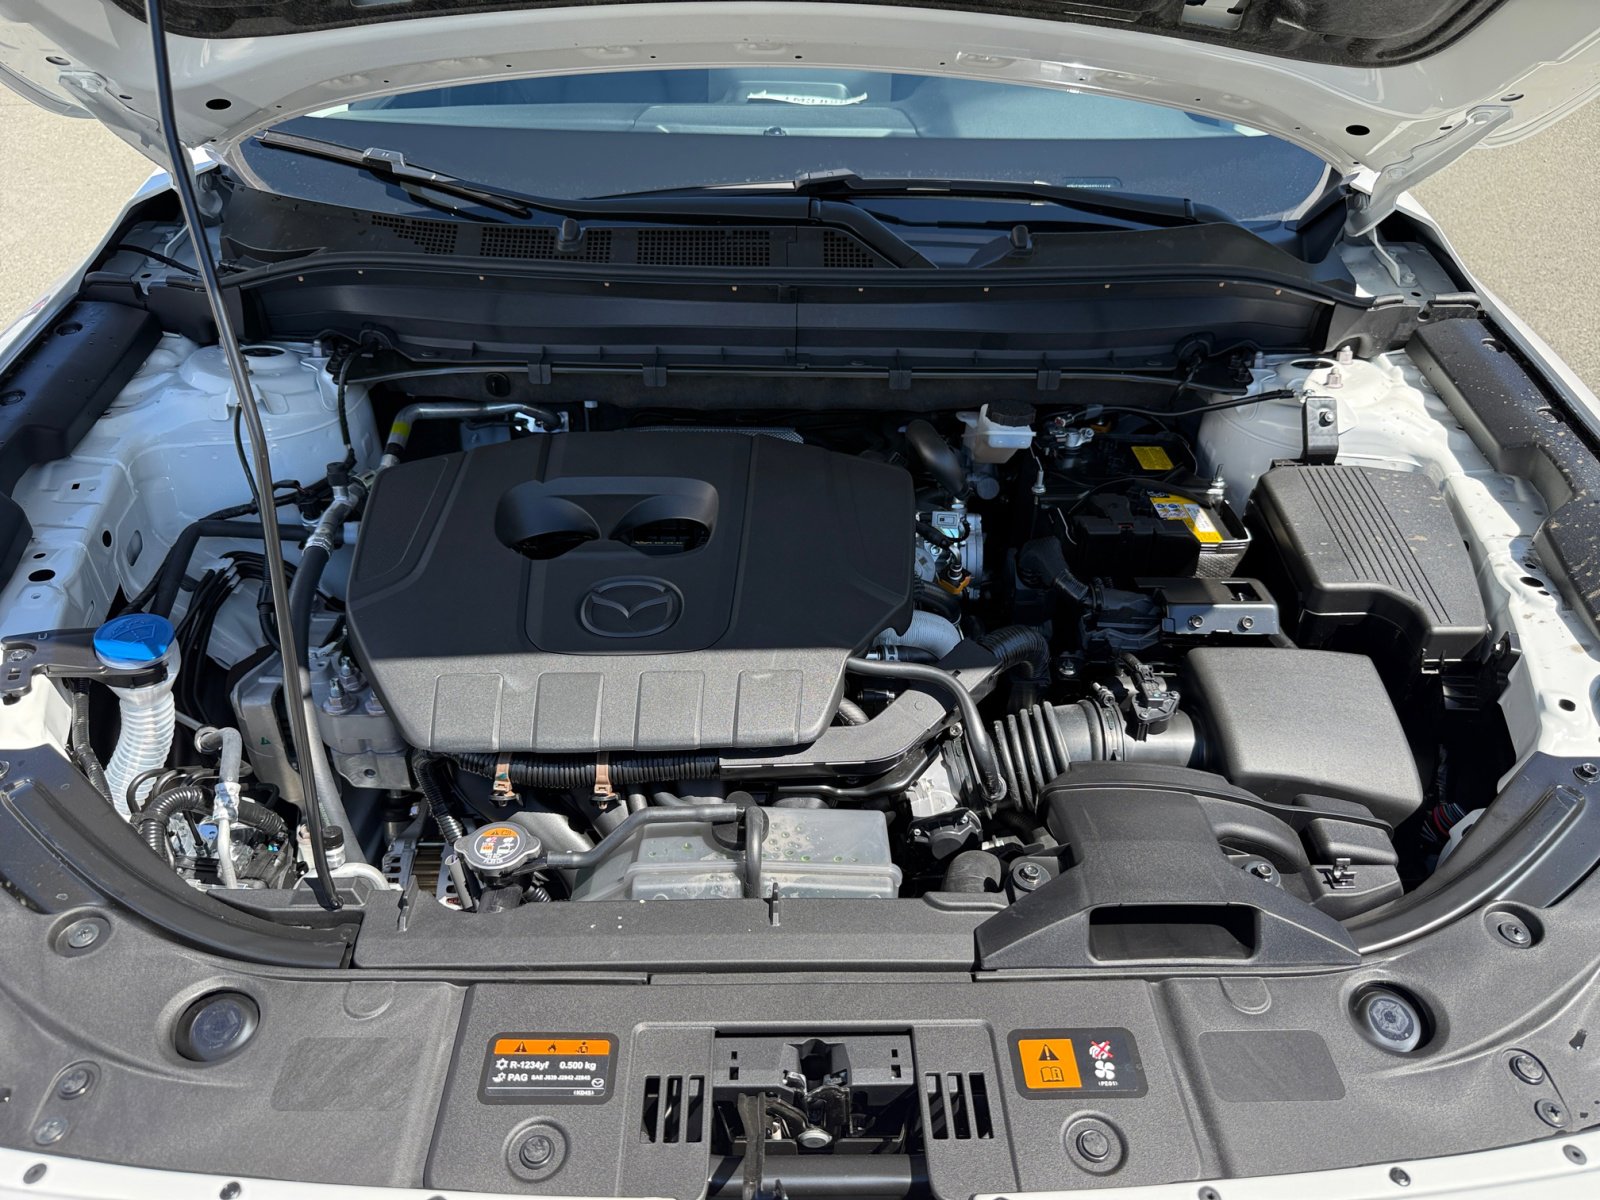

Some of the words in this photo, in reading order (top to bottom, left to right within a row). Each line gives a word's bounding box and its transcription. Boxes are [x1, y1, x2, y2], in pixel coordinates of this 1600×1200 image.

[509, 1061, 549, 1070] R-1234yf
[559, 1061, 583, 1069] 0.500
[585, 1061, 597, 1071] kg
[507, 1073, 528, 1081] PAG
